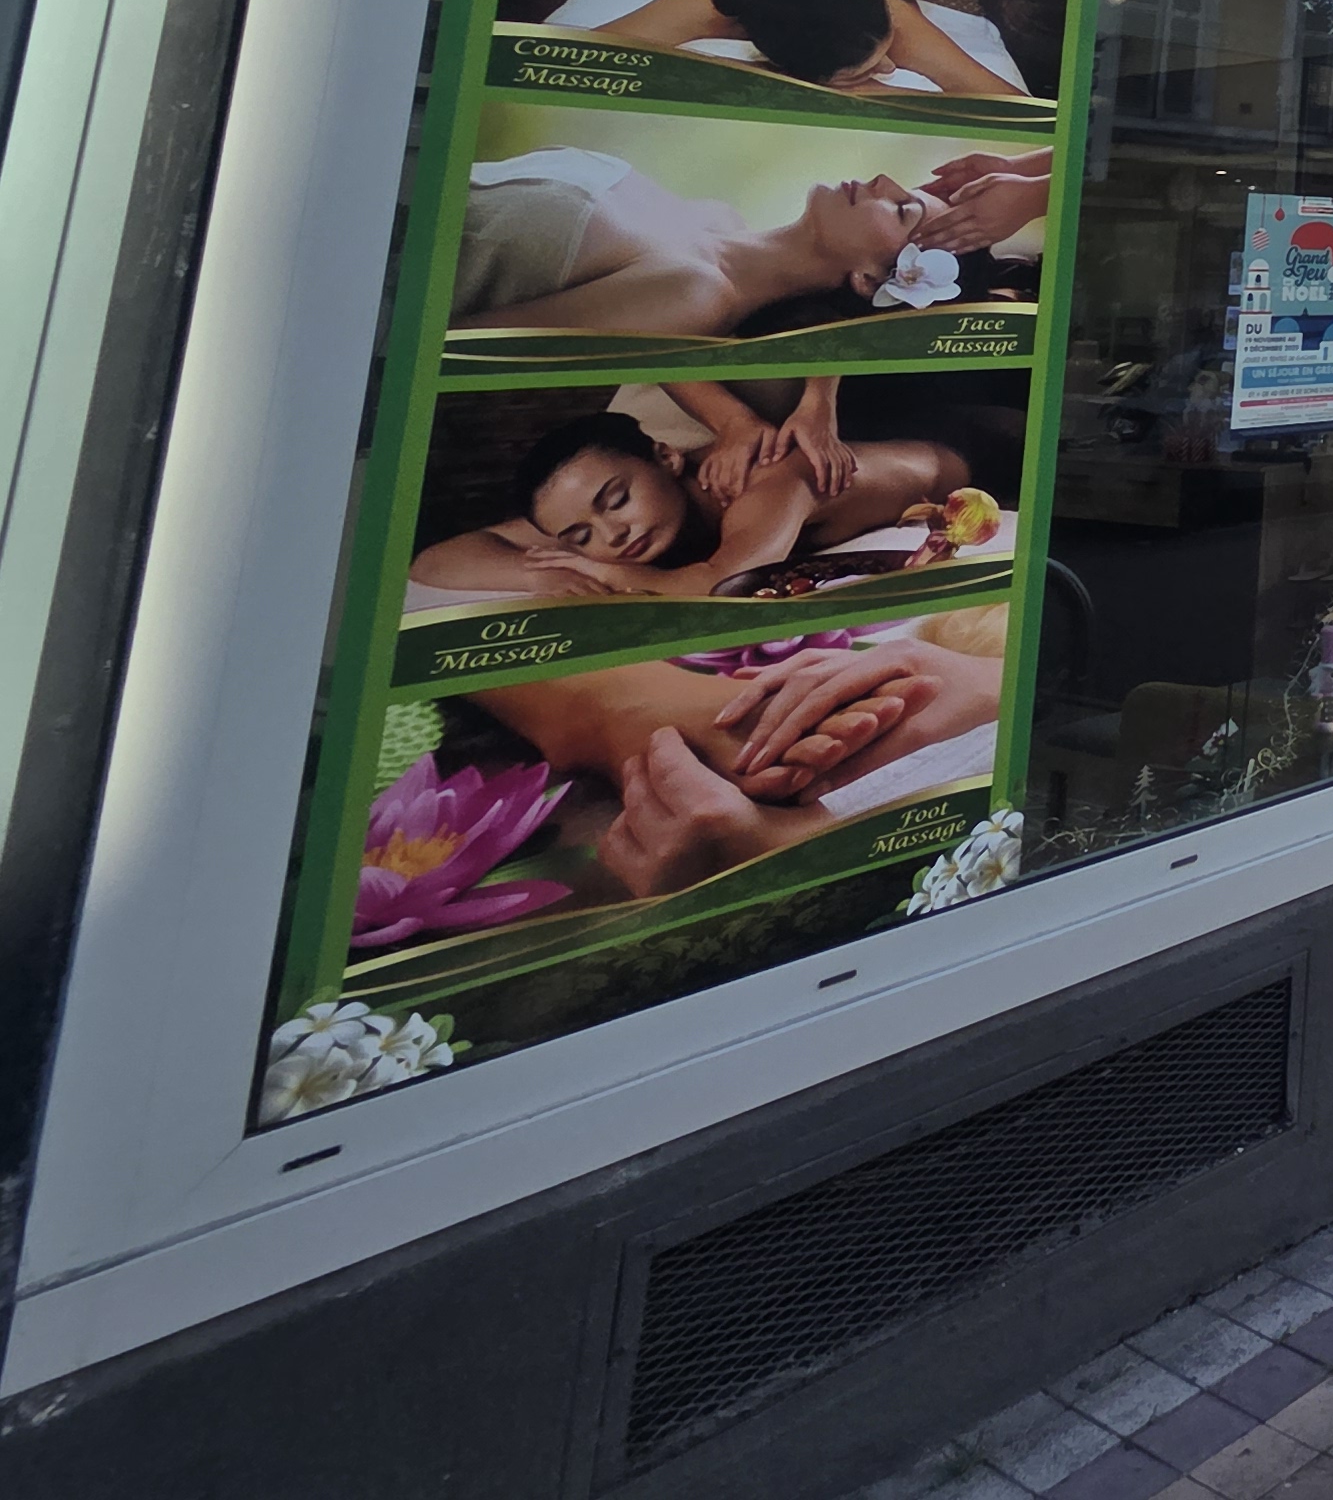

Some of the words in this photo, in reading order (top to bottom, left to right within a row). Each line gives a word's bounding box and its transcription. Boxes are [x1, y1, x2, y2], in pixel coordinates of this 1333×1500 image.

[513, 38, 653, 70] Compress
[513, 66, 643, 96] Massage
[1283, 246, 1331, 278] Grand
[1294, 264, 1328, 287] Jeu
[955, 316, 1006, 335] Face
[1246, 323, 1263, 334] DU
[926, 337, 1018, 357] Massage
[480, 615, 531, 642] Oil
[430, 636, 574, 676] Massage
[900, 800, 951, 831] Foot
[867, 815, 968, 859] Massage
